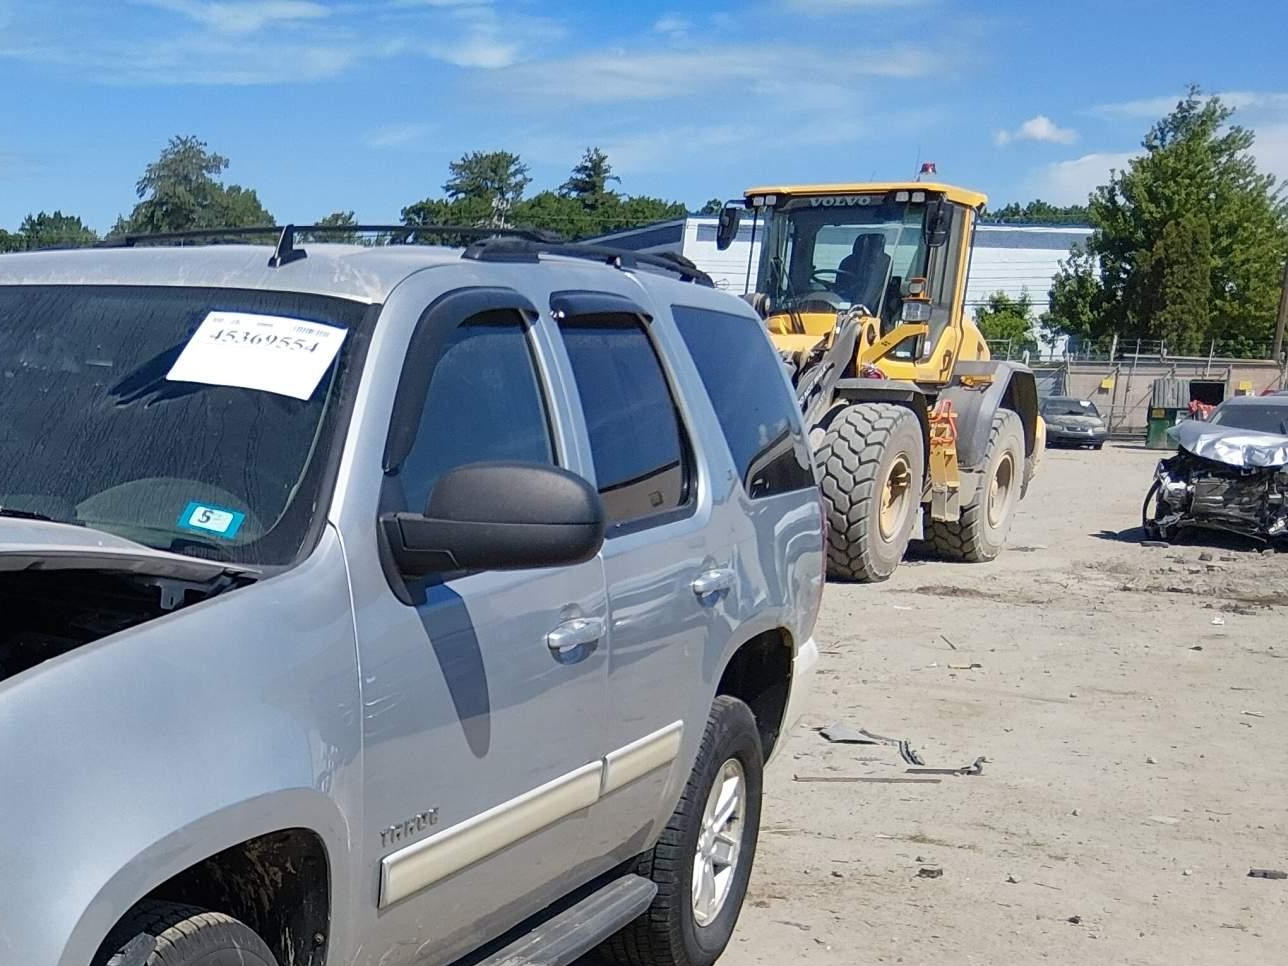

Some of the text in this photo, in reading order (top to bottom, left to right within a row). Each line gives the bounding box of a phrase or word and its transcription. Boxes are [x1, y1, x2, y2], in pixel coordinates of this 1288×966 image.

[809, 196, 871, 207] VOLVO
[209, 328, 320, 353] 45369554
[198, 509, 214, 523] 5
